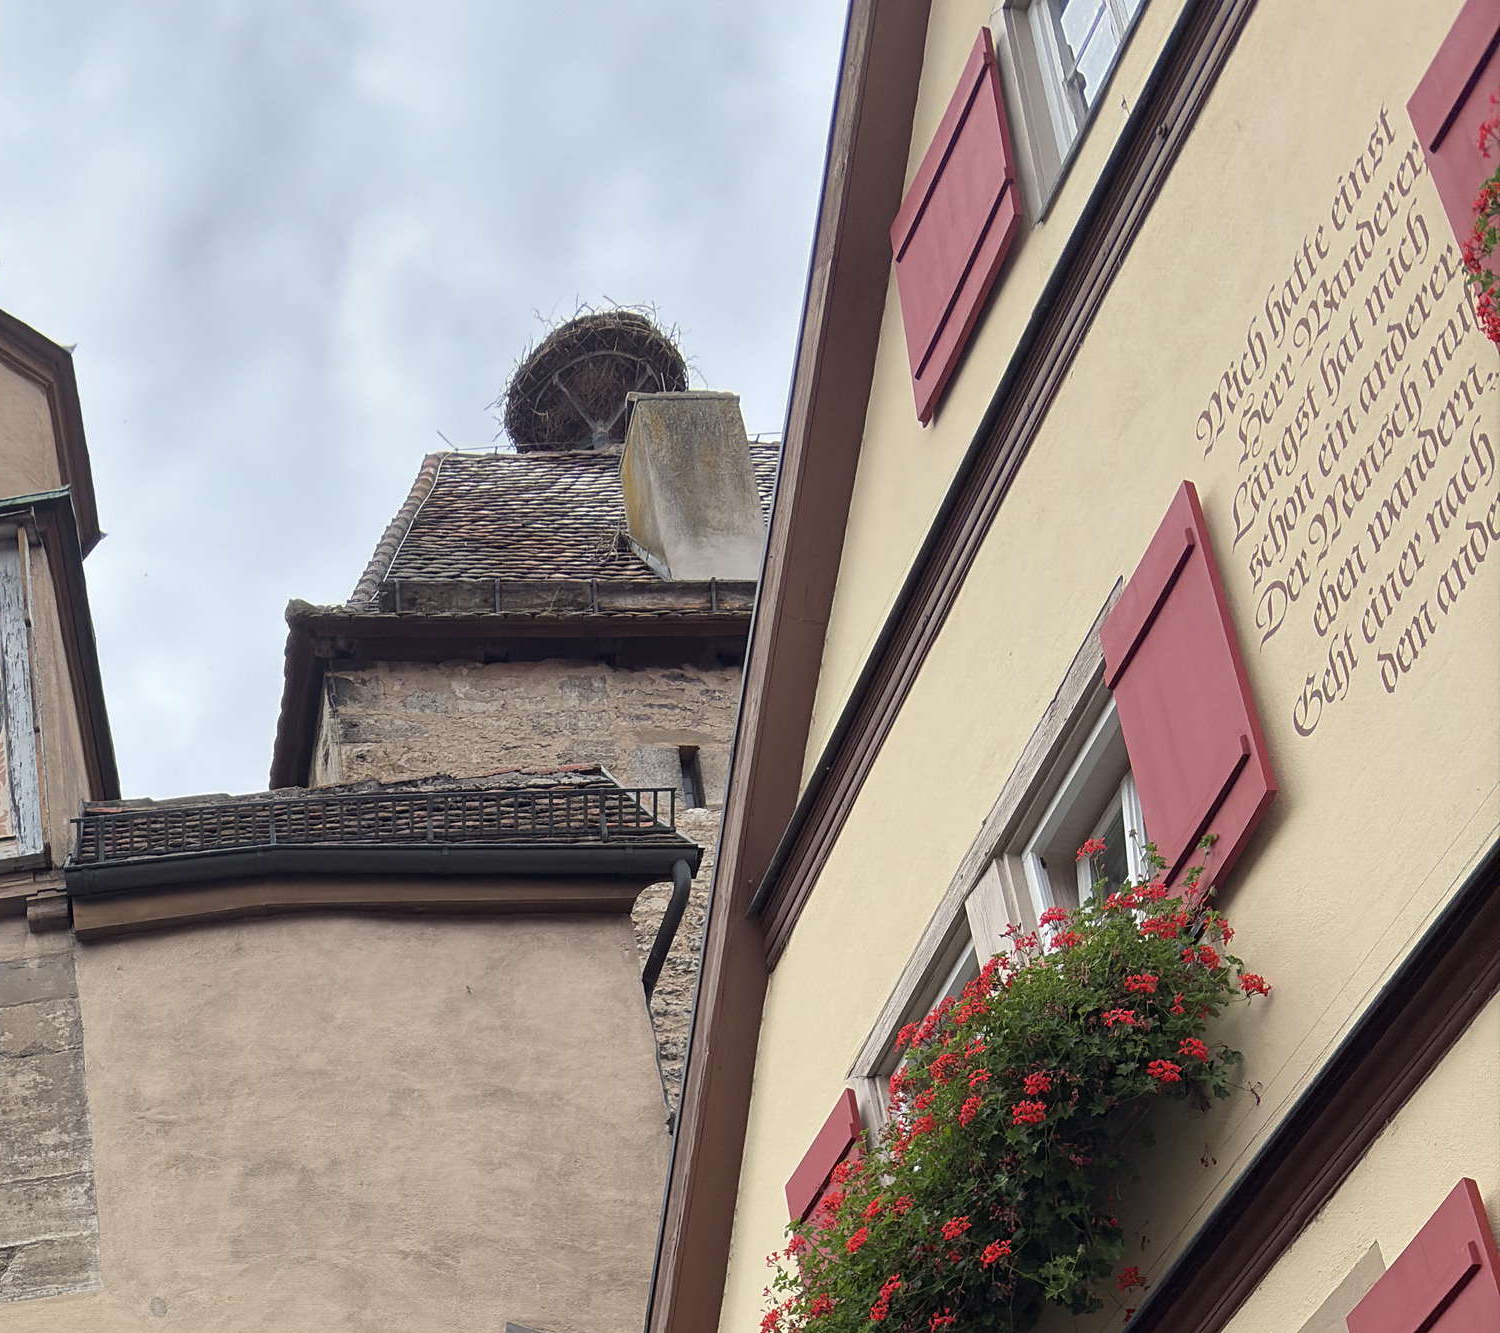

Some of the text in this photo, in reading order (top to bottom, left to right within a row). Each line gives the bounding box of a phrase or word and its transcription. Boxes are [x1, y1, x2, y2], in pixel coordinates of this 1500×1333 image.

[1195, 101, 1396, 462] Mich hatte einst
[1232, 198, 1430, 554] Längst hat mich
[1238, 353, 1296, 472] Herr
[1249, 470, 1316, 594] schon
[1318, 404, 1358, 477] ein
[1255, 549, 1311, 653] Der
[1308, 364, 1422, 568] Mensch
[1293, 415, 1495, 737] Geht einer nach
[1313, 541, 1368, 637] eben
[1377, 491, 1500, 694] dem ande
